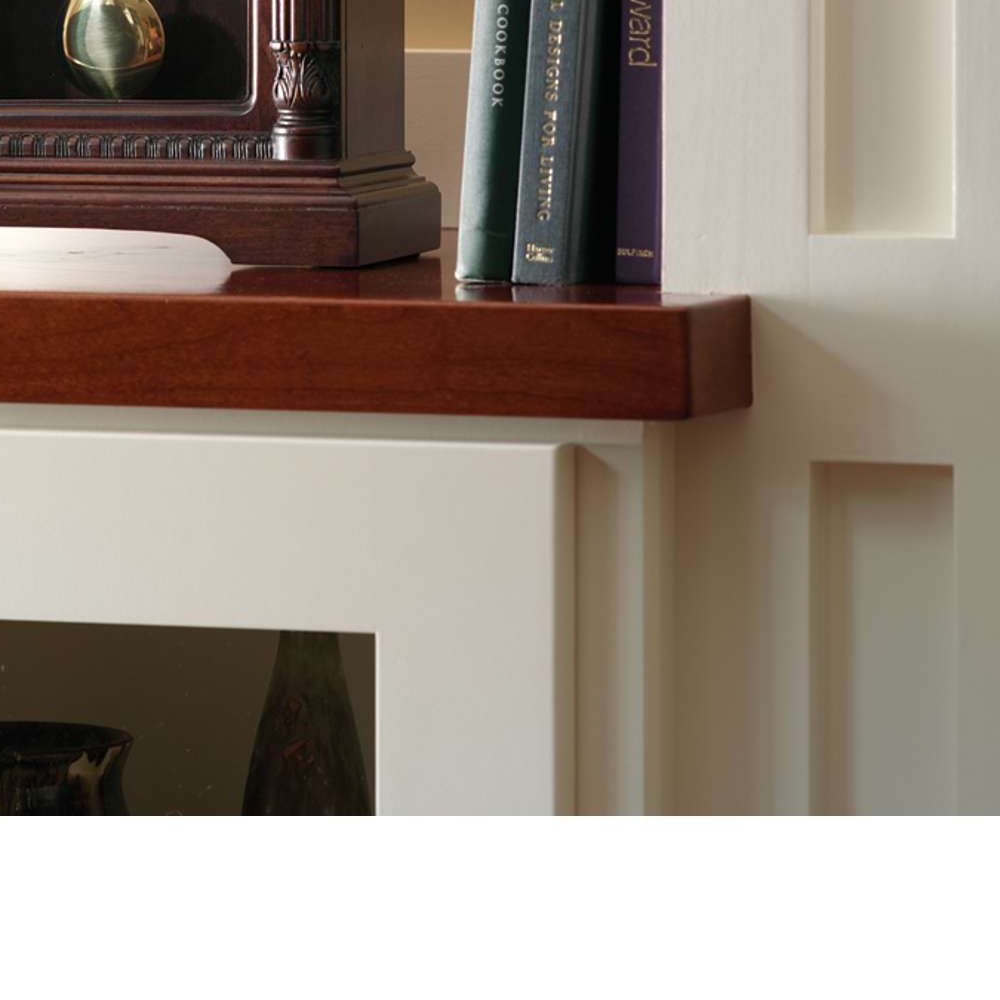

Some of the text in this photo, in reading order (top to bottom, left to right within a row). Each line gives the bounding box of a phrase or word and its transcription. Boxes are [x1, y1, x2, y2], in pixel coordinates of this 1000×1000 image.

[491, 3, 510, 107] COOKBOOK
[544, 20, 563, 102] DESIGNS
[541, 110, 558, 148] FOR
[536, 155, 555, 222] LIVING
